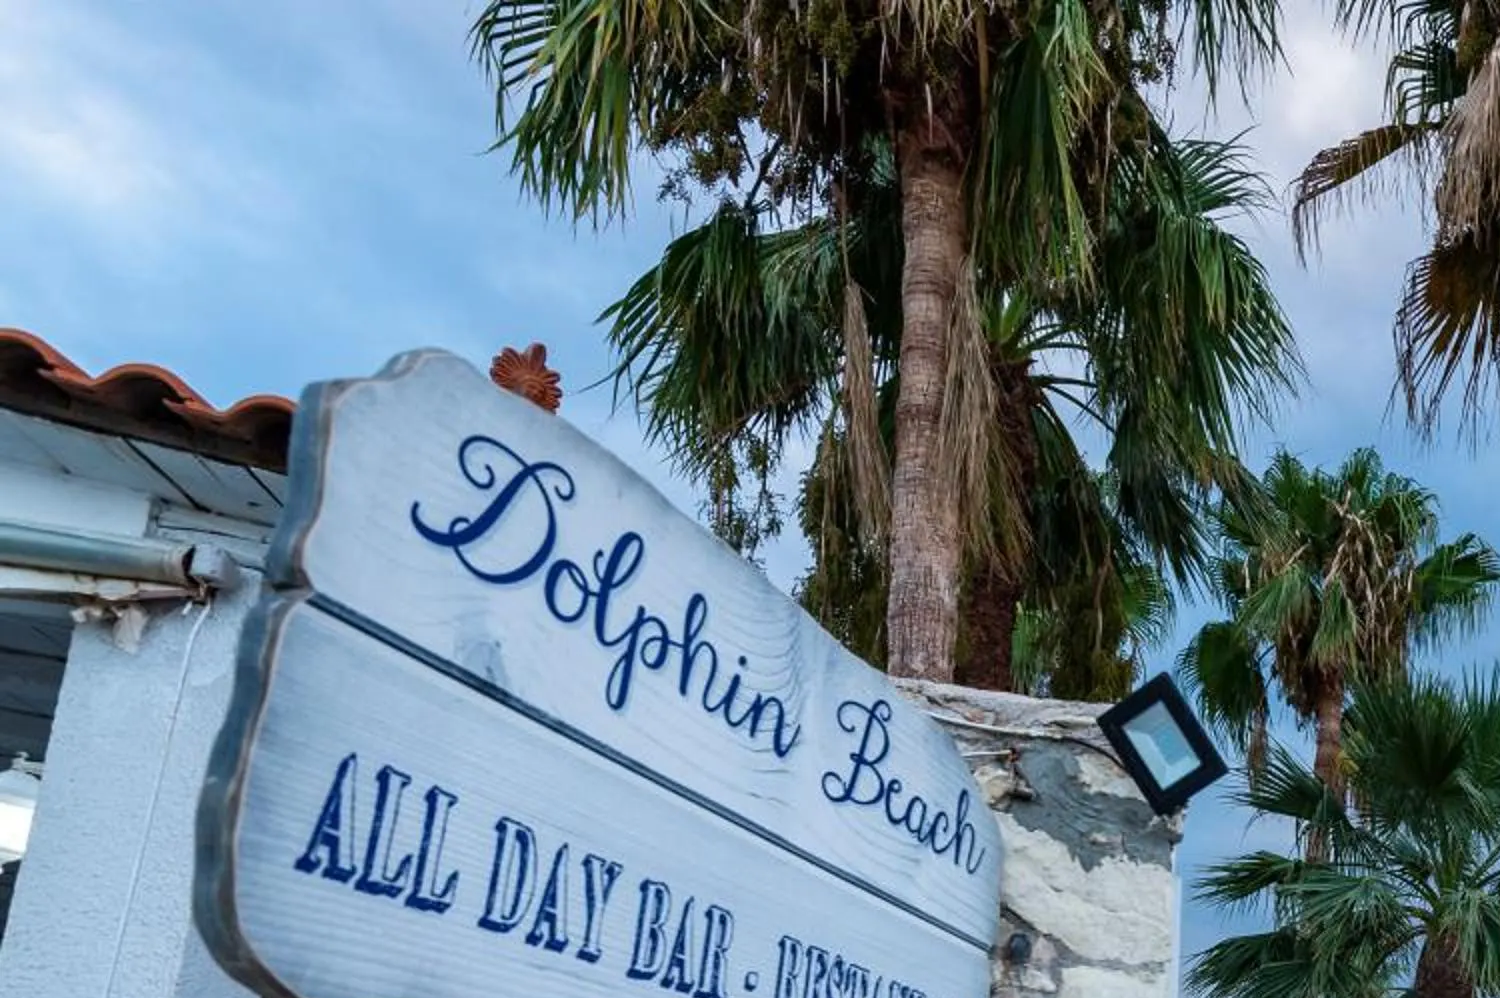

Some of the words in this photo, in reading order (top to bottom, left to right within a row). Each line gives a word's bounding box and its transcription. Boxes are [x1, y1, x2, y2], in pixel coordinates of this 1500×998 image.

[410, 434, 802, 760] Dolphin
[821, 698, 986, 877] Beach
[294, 752, 460, 915] ALL
[477, 816, 624, 964] DAY
